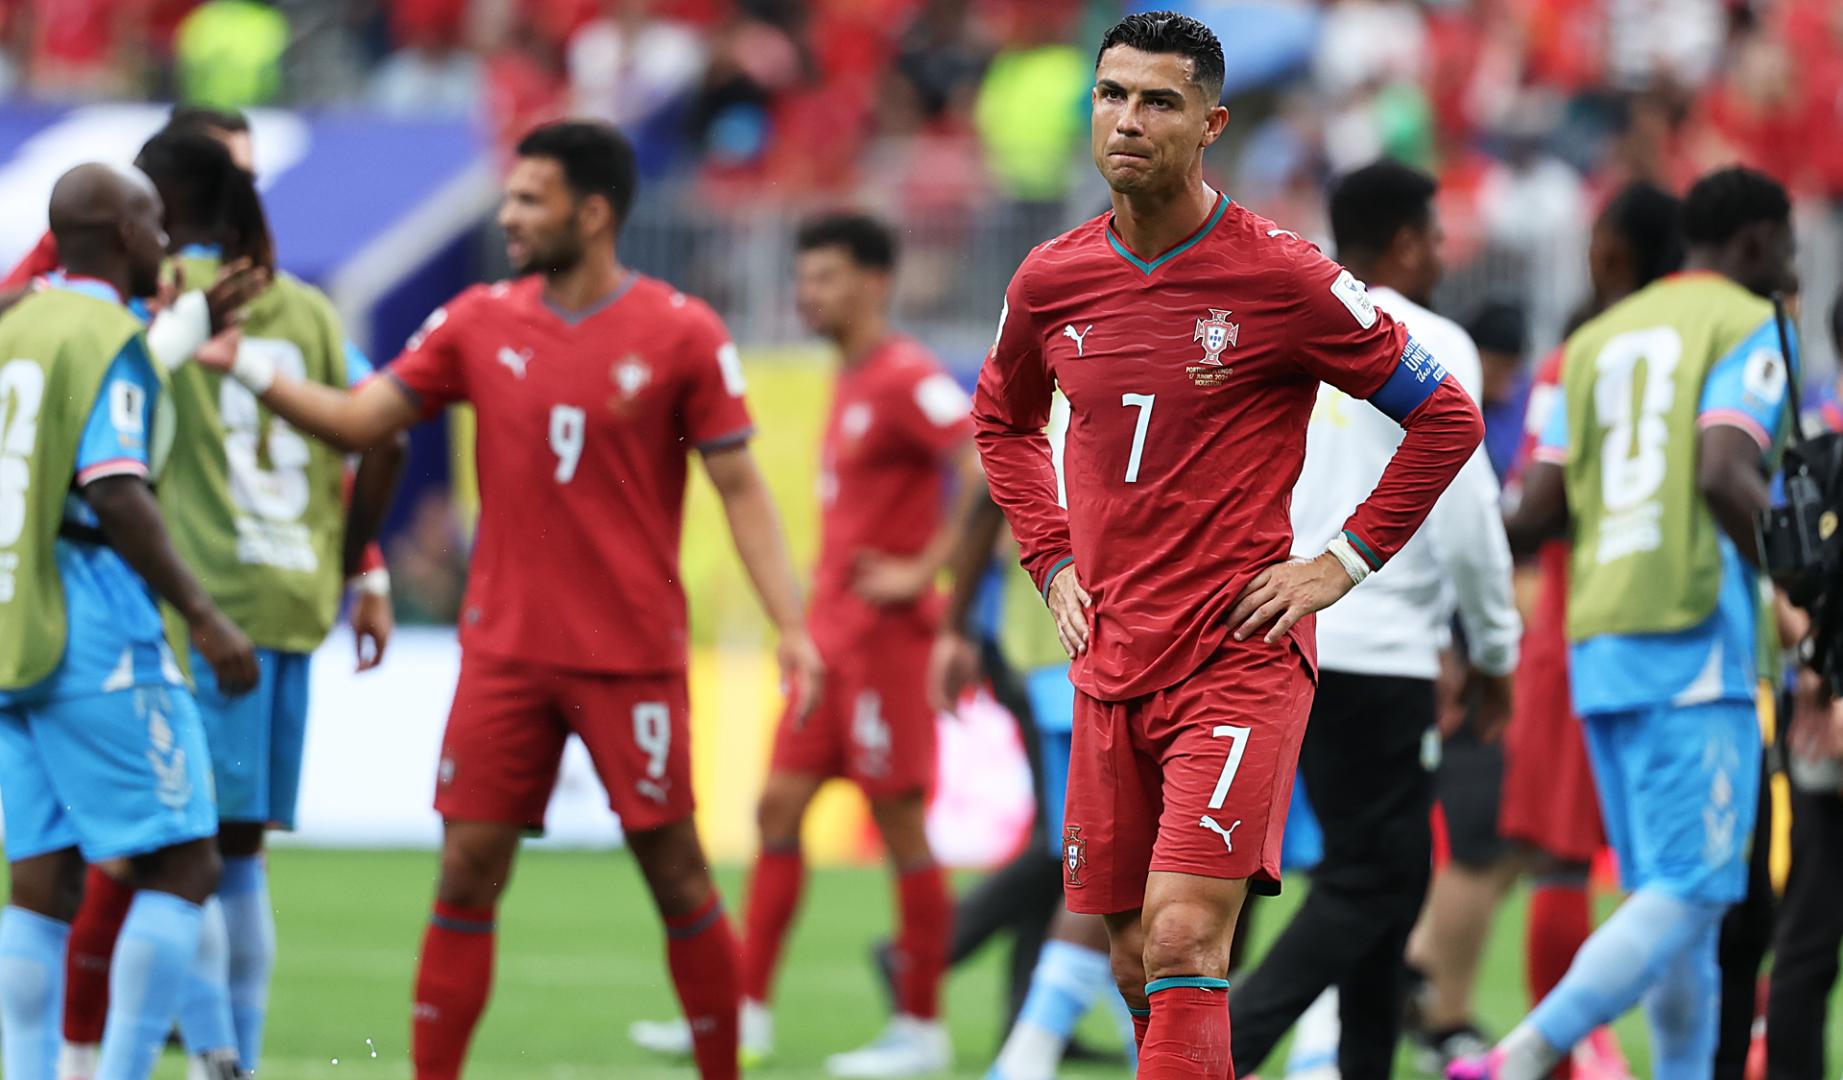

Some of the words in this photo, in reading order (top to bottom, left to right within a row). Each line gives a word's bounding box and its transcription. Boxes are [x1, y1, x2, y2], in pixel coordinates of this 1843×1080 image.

[549, 404, 586, 484] 9
[1122, 393, 1155, 482] 7
[631, 702, 671, 779] 9
[1208, 725, 1251, 809] 7
